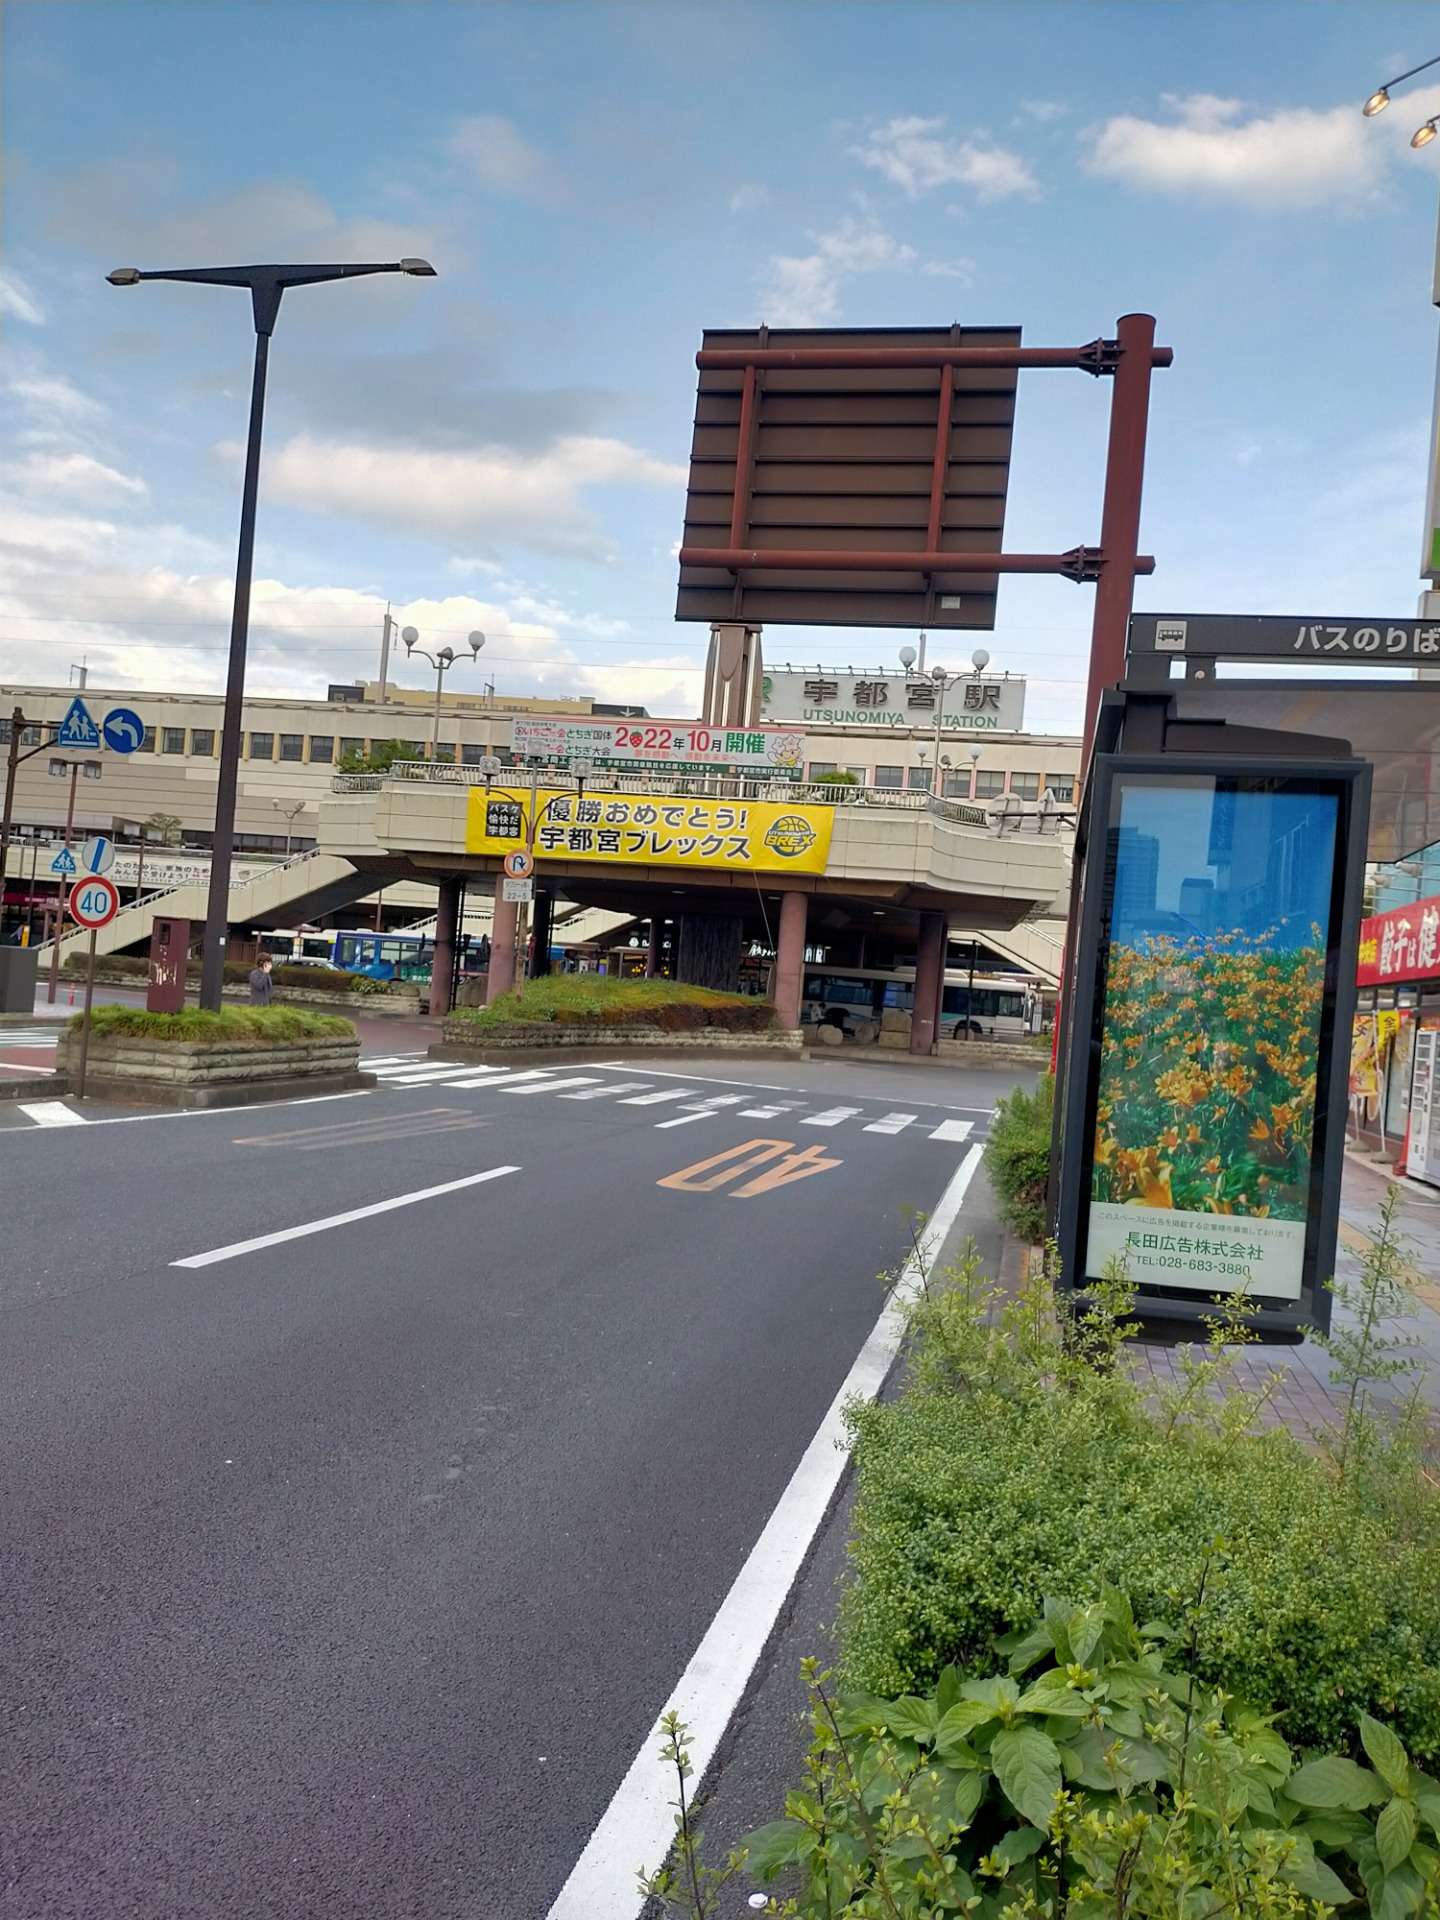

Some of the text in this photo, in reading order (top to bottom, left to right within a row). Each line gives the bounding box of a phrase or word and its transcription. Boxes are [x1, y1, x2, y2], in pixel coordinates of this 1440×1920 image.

[1294, 624, 1440, 653] バスのりば
[803, 679, 1001, 711] 宇都宮駅
[803, 708, 998, 728] UTSUNOMIYA STATION
[539, 826, 751, 860] 宇都宮ブレックス
[765, 834, 816, 847] BREX
[81, 891, 108, 914] 40
[1126, 1231, 1264, 1261] 長田広告株式会社
[1136, 1254, 1250, 1275] TEL:028-683-3880
